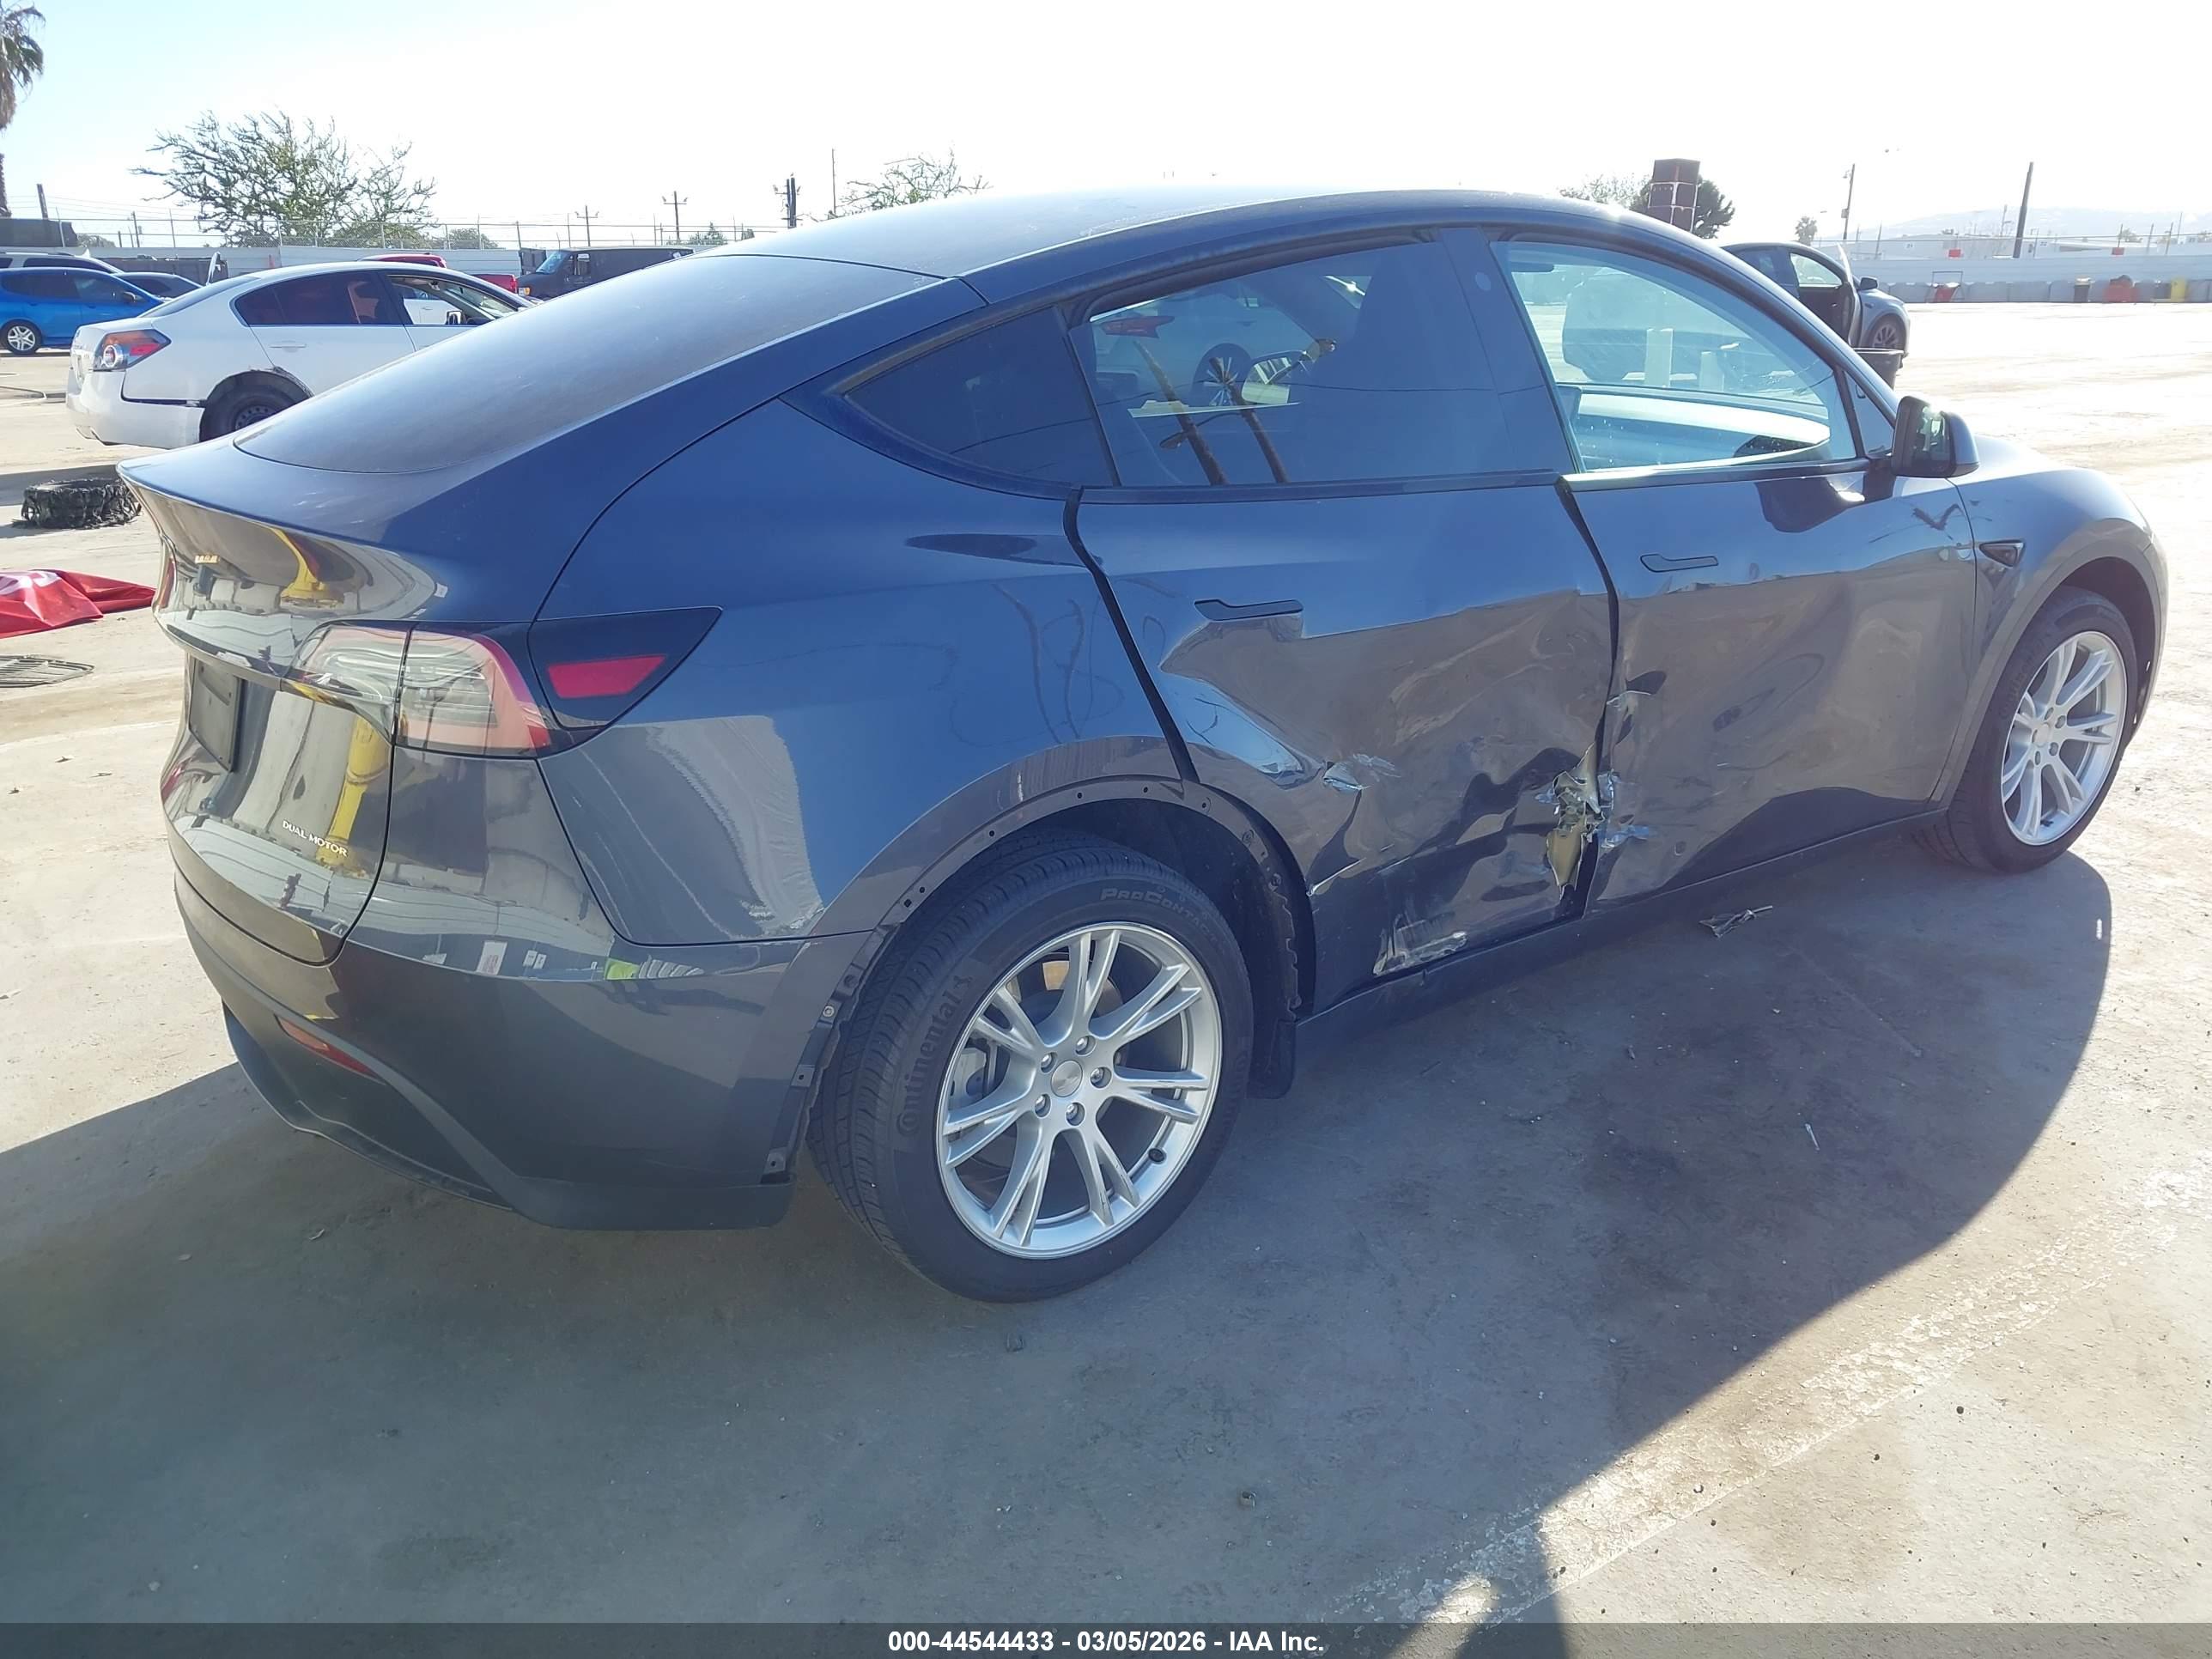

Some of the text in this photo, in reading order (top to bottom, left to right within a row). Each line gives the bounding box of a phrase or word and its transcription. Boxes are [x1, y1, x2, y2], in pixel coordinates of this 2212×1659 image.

[282, 819, 348, 857] DUAL MOTOR
[896, 990, 963, 1137] Continental
